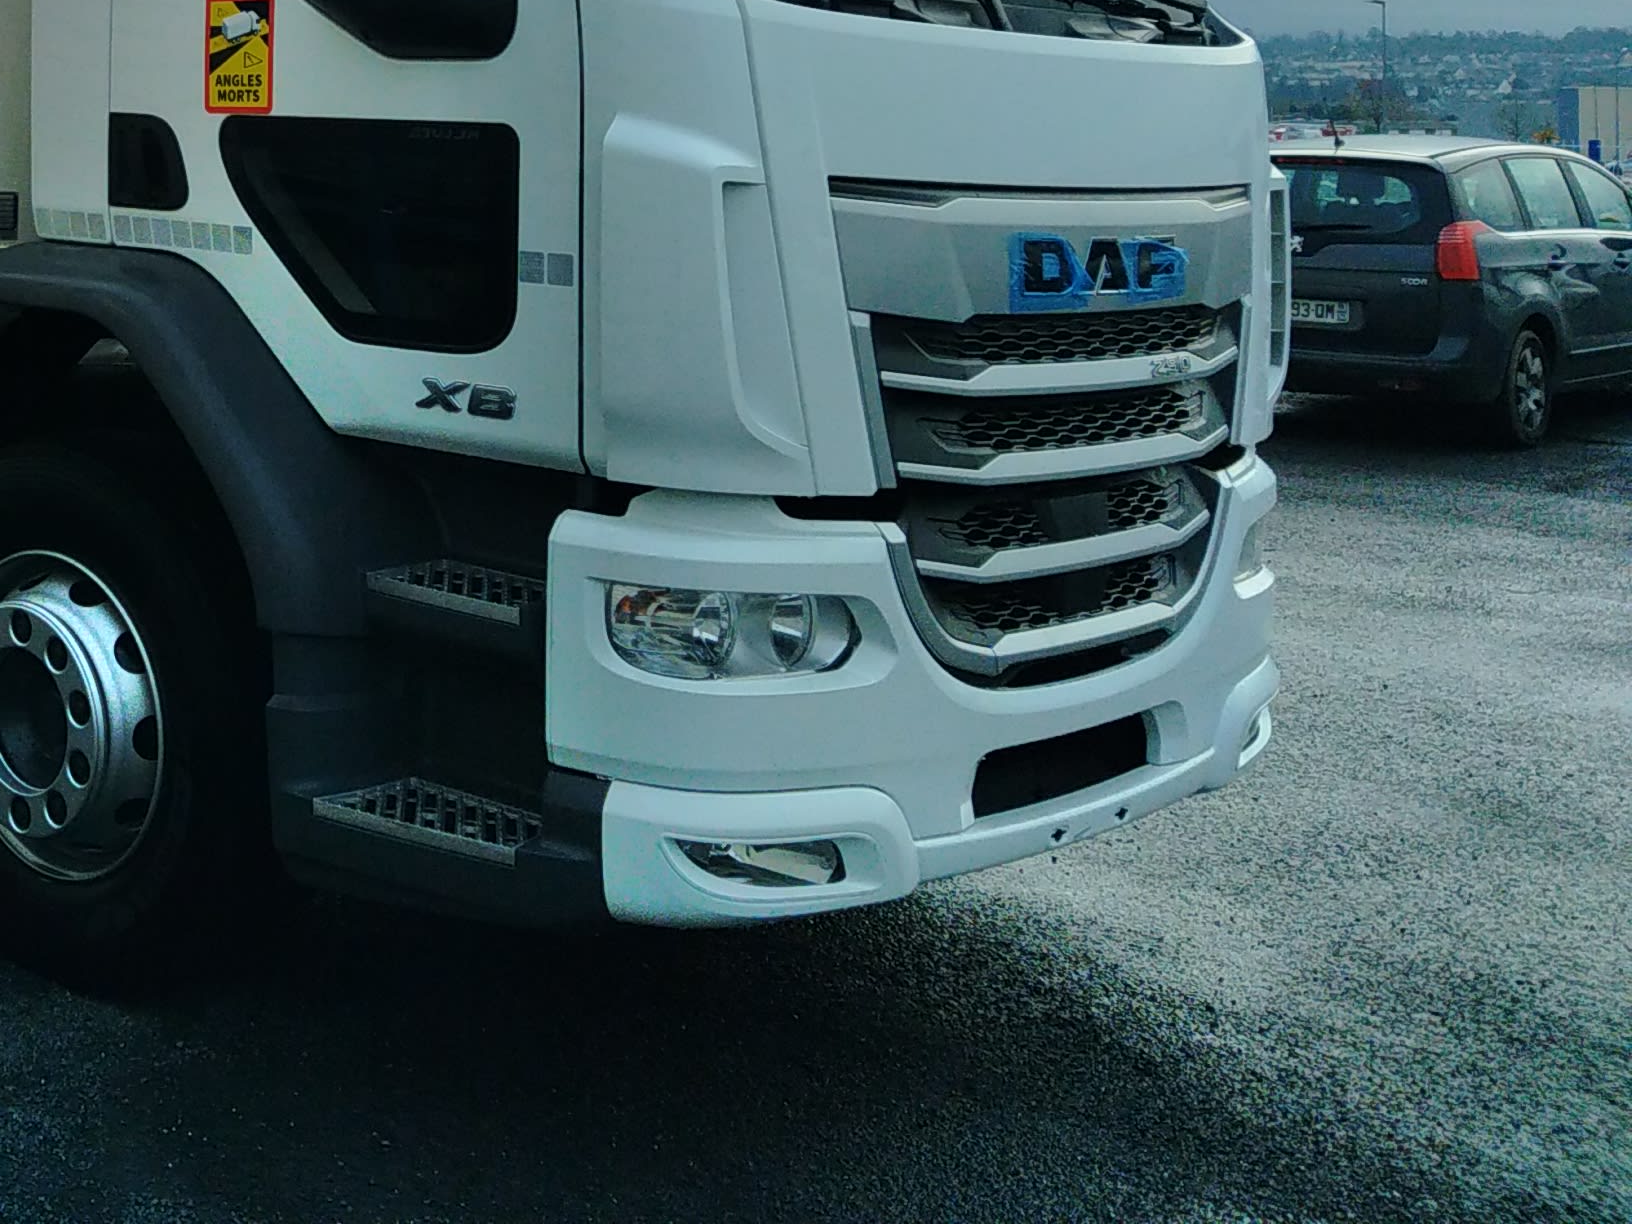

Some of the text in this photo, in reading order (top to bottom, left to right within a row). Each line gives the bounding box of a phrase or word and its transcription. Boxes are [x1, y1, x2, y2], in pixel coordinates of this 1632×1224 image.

[215, 74, 263, 88] ANGLES
[217, 89, 261, 103] MORTS
[1023, 233, 1177, 296] DAF
[415, 376, 518, 421] XB
